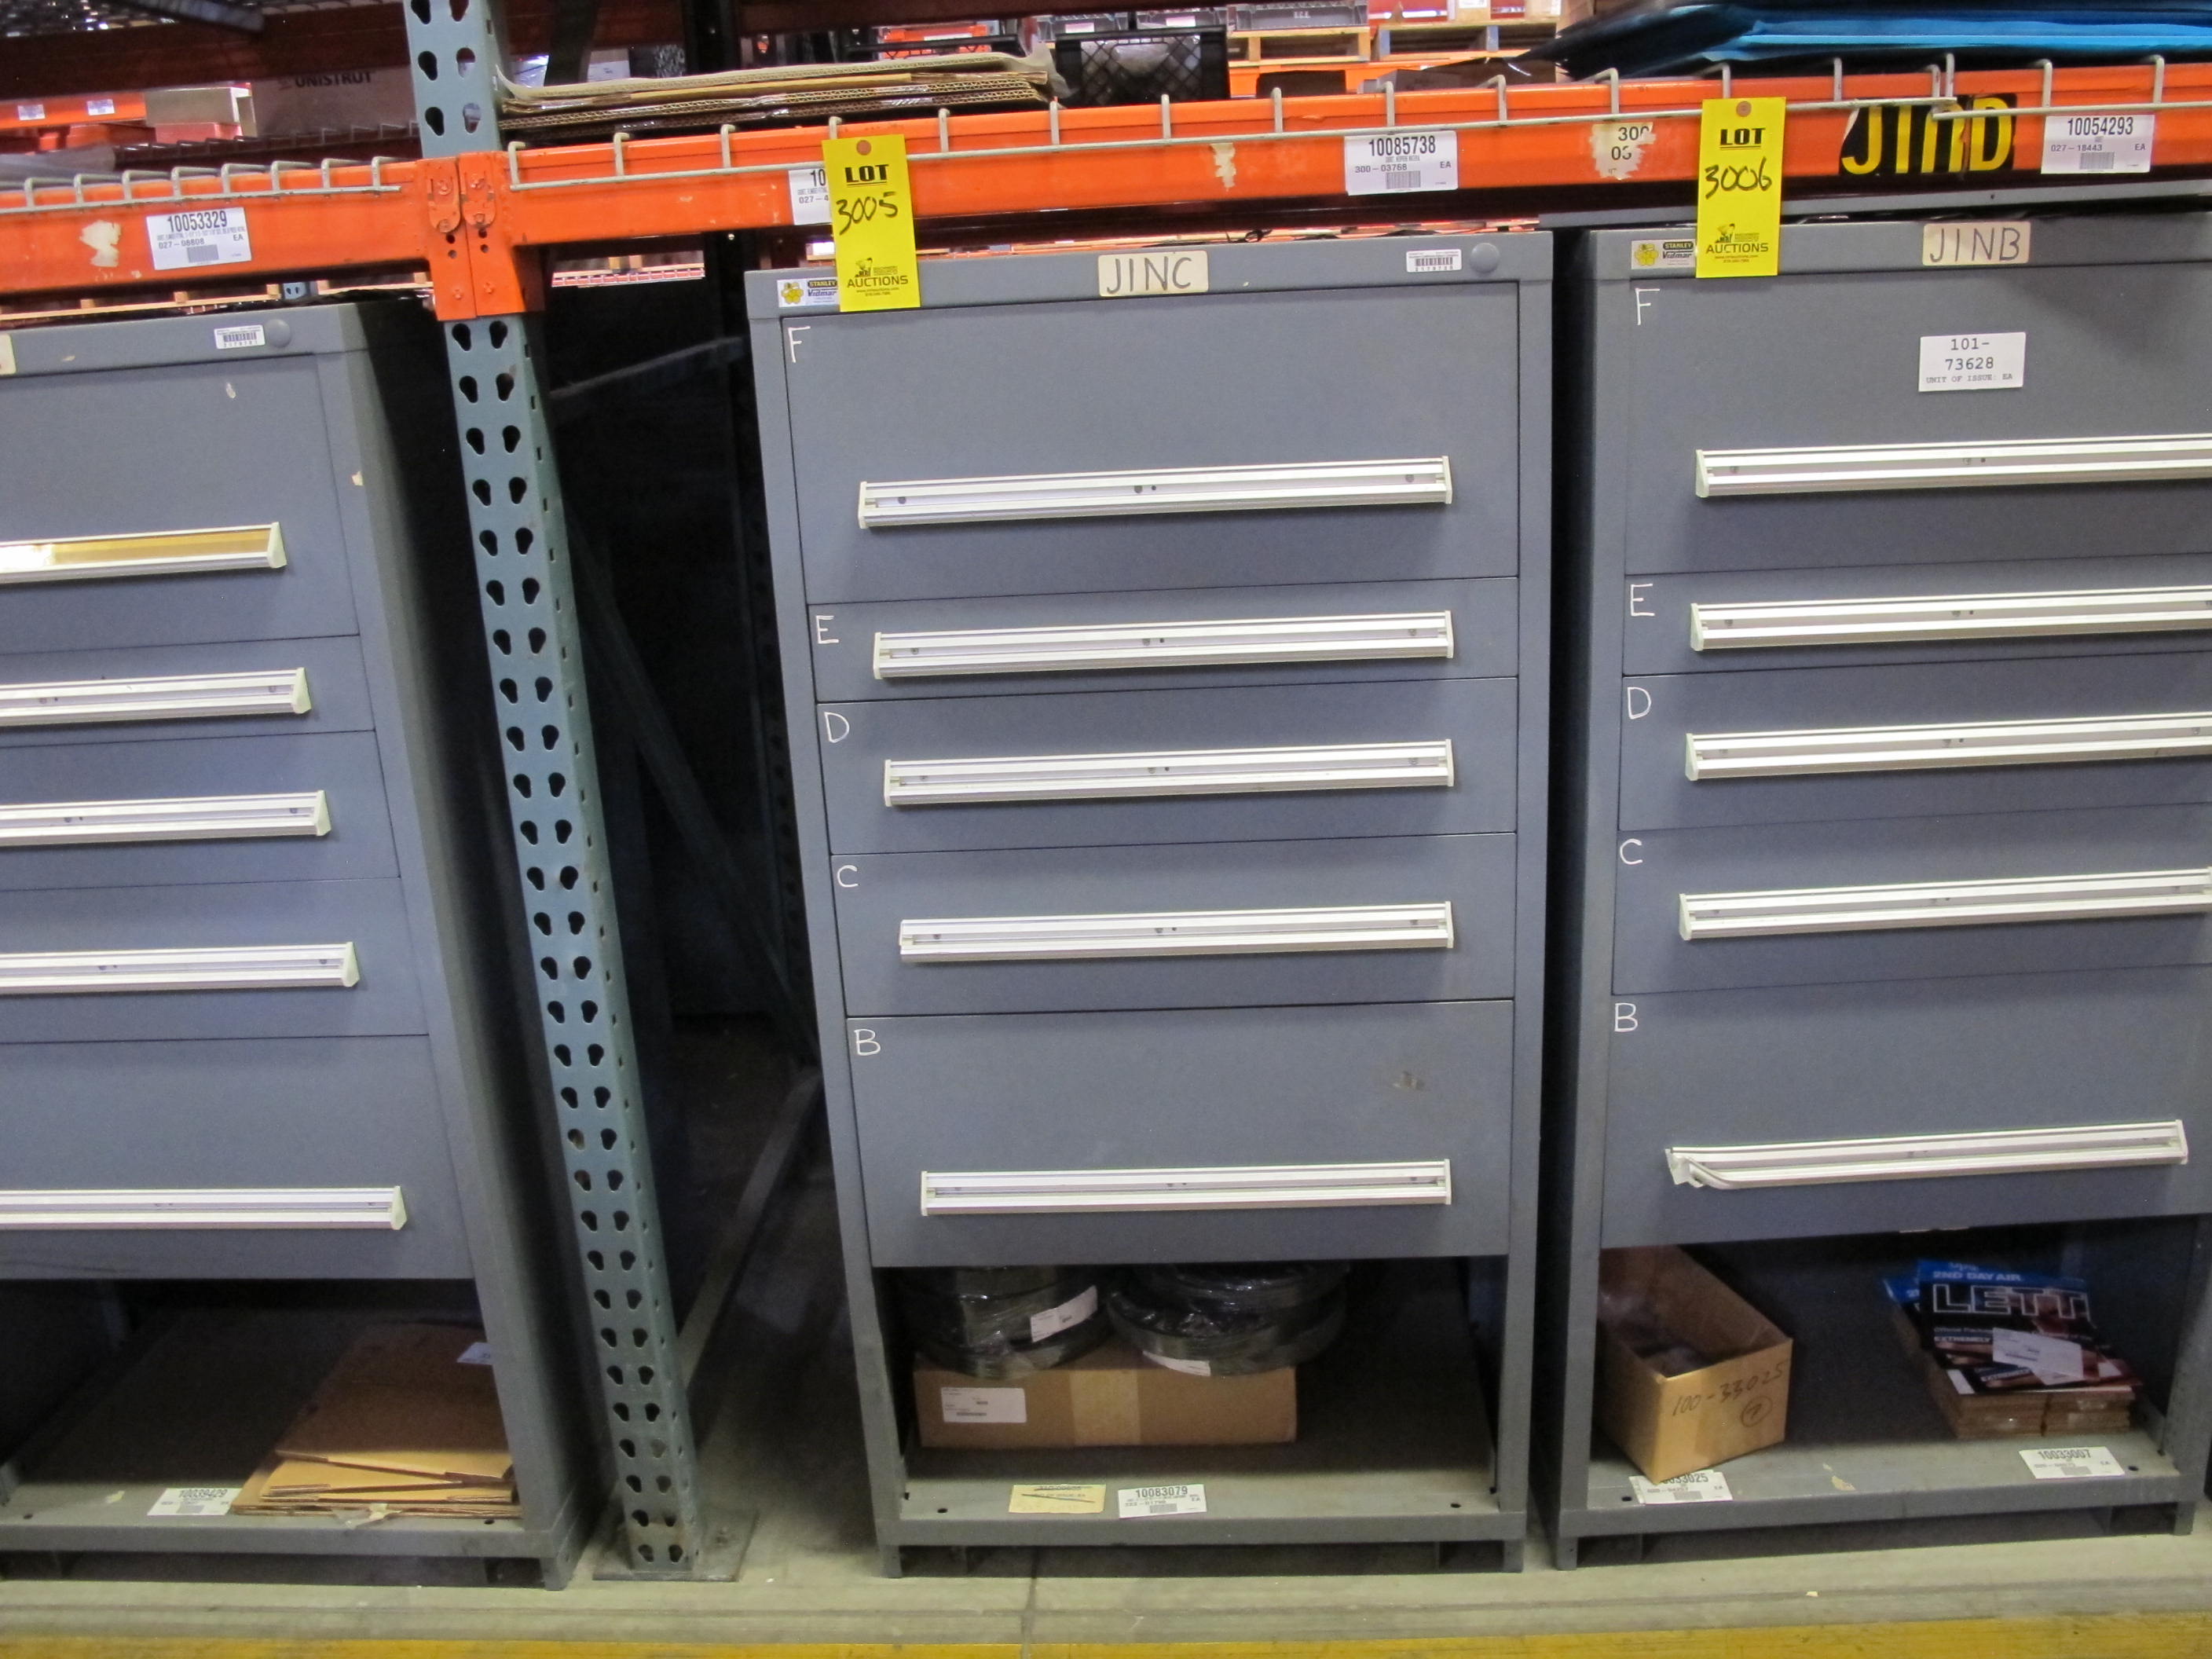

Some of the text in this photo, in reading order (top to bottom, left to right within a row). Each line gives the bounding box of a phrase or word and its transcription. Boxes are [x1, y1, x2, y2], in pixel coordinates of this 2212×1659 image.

[295, 71, 371, 87] UNISTRUT
[1720, 128, 1766, 145] LOT
[2067, 117, 2133, 135] 10054293
[1368, 135, 1436, 156] 10085738
[810, 168, 826, 187] 10
[845, 164, 888, 183] LOT
[1705, 156, 1772, 200] 3006
[167, 211, 228, 233] 10053329
[836, 191, 898, 236] 3005
[1706, 242, 1769, 254] AUCTIONS
[1929, 227, 2020, 262] JINB
[847, 275, 909, 288] AUCTIONS
[1106, 256, 1192, 295] JINC
[1635, 287, 1661, 326] F
[788, 326, 811, 363] F
[1950, 338, 1990, 350] 101-
[1945, 357, 1994, 371] 73628
[1630, 583, 1655, 617] E
[815, 615, 840, 644] E
[1627, 687, 1652, 720] D
[823, 711, 850, 743] D
[1619, 838, 1643, 865] C
[837, 865, 859, 888] C
[1614, 1002, 1639, 1032] B
[853, 1028, 881, 1057] B
[1136, 1485, 1188, 1497] 10083079
